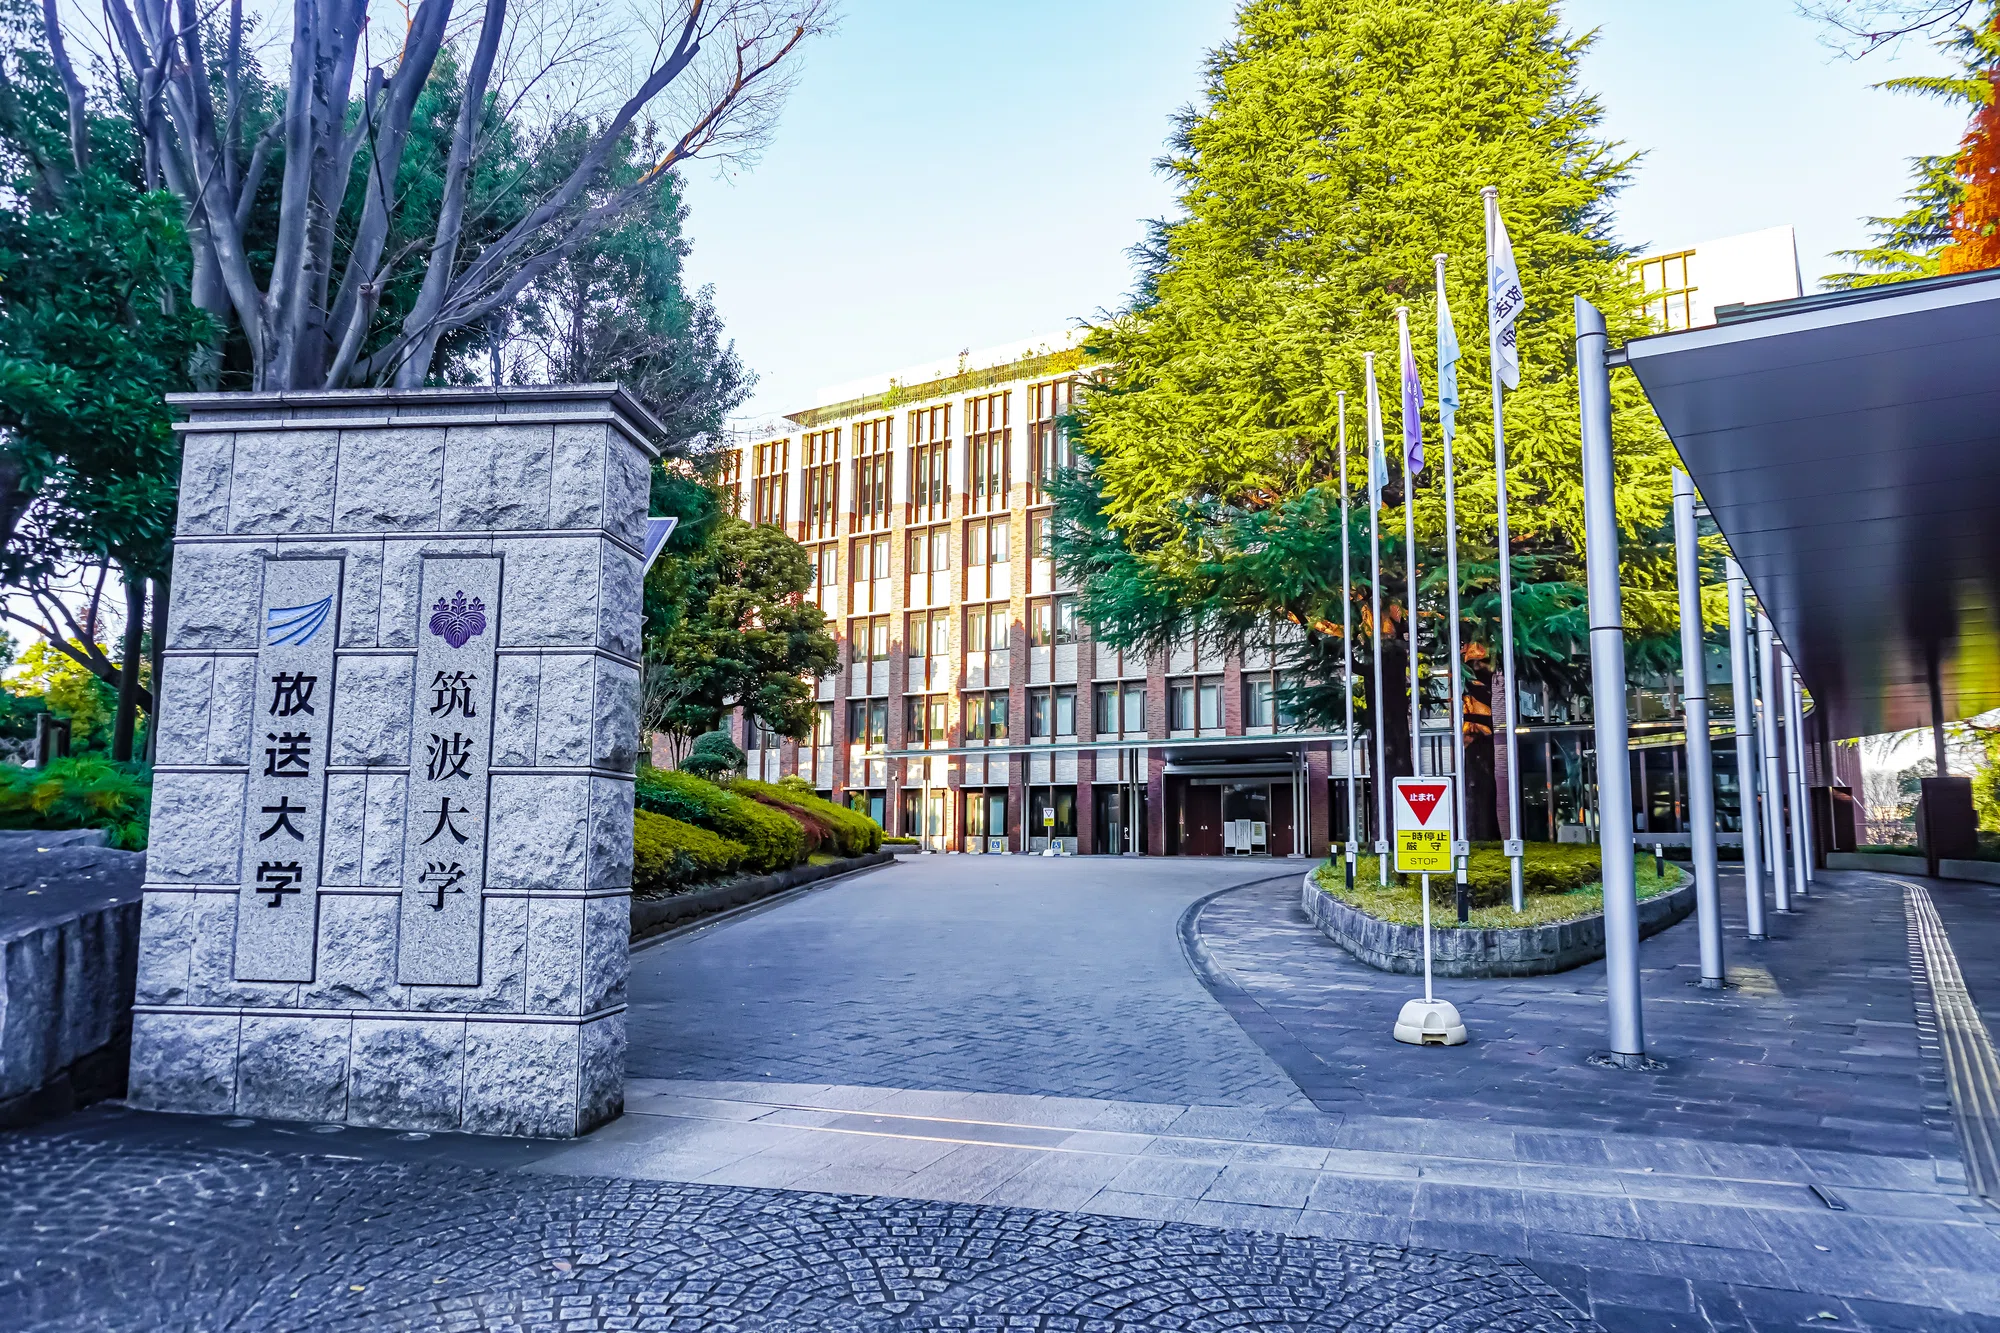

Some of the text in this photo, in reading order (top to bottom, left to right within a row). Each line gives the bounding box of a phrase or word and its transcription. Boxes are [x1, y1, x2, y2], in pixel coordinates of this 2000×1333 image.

[256, 671, 318, 909] 放送大学
[417, 670, 478, 912] 筑波大学
[1409, 793, 1436, 802] 止まれ
[1400, 832, 1447, 841] 一時停止
[1410, 857, 1438, 865] STOP
